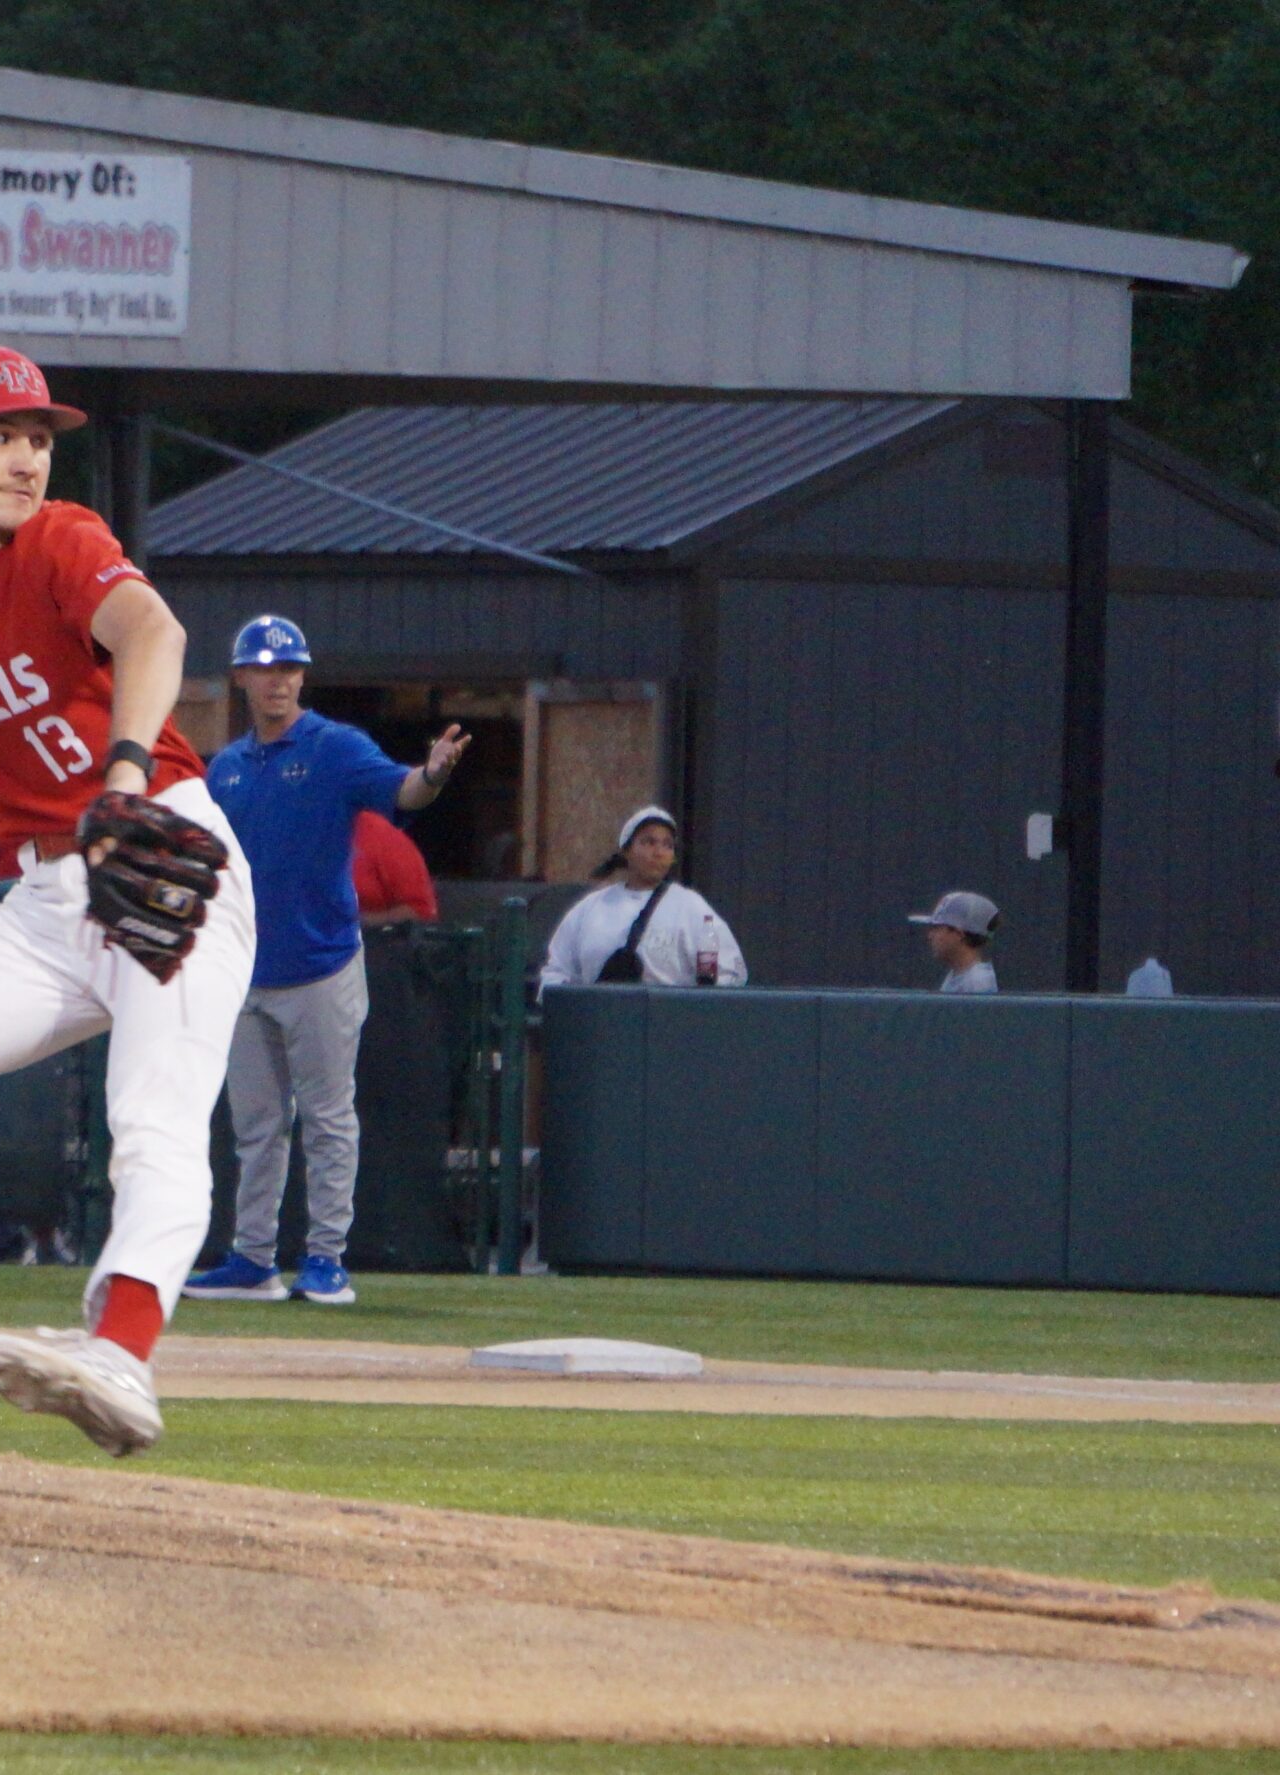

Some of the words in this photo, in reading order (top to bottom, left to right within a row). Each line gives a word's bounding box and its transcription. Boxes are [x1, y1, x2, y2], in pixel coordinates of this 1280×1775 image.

[90, 162, 136, 197] Of:
[22, 202, 176, 277] Swanner
[23, 715, 93, 783] 13
